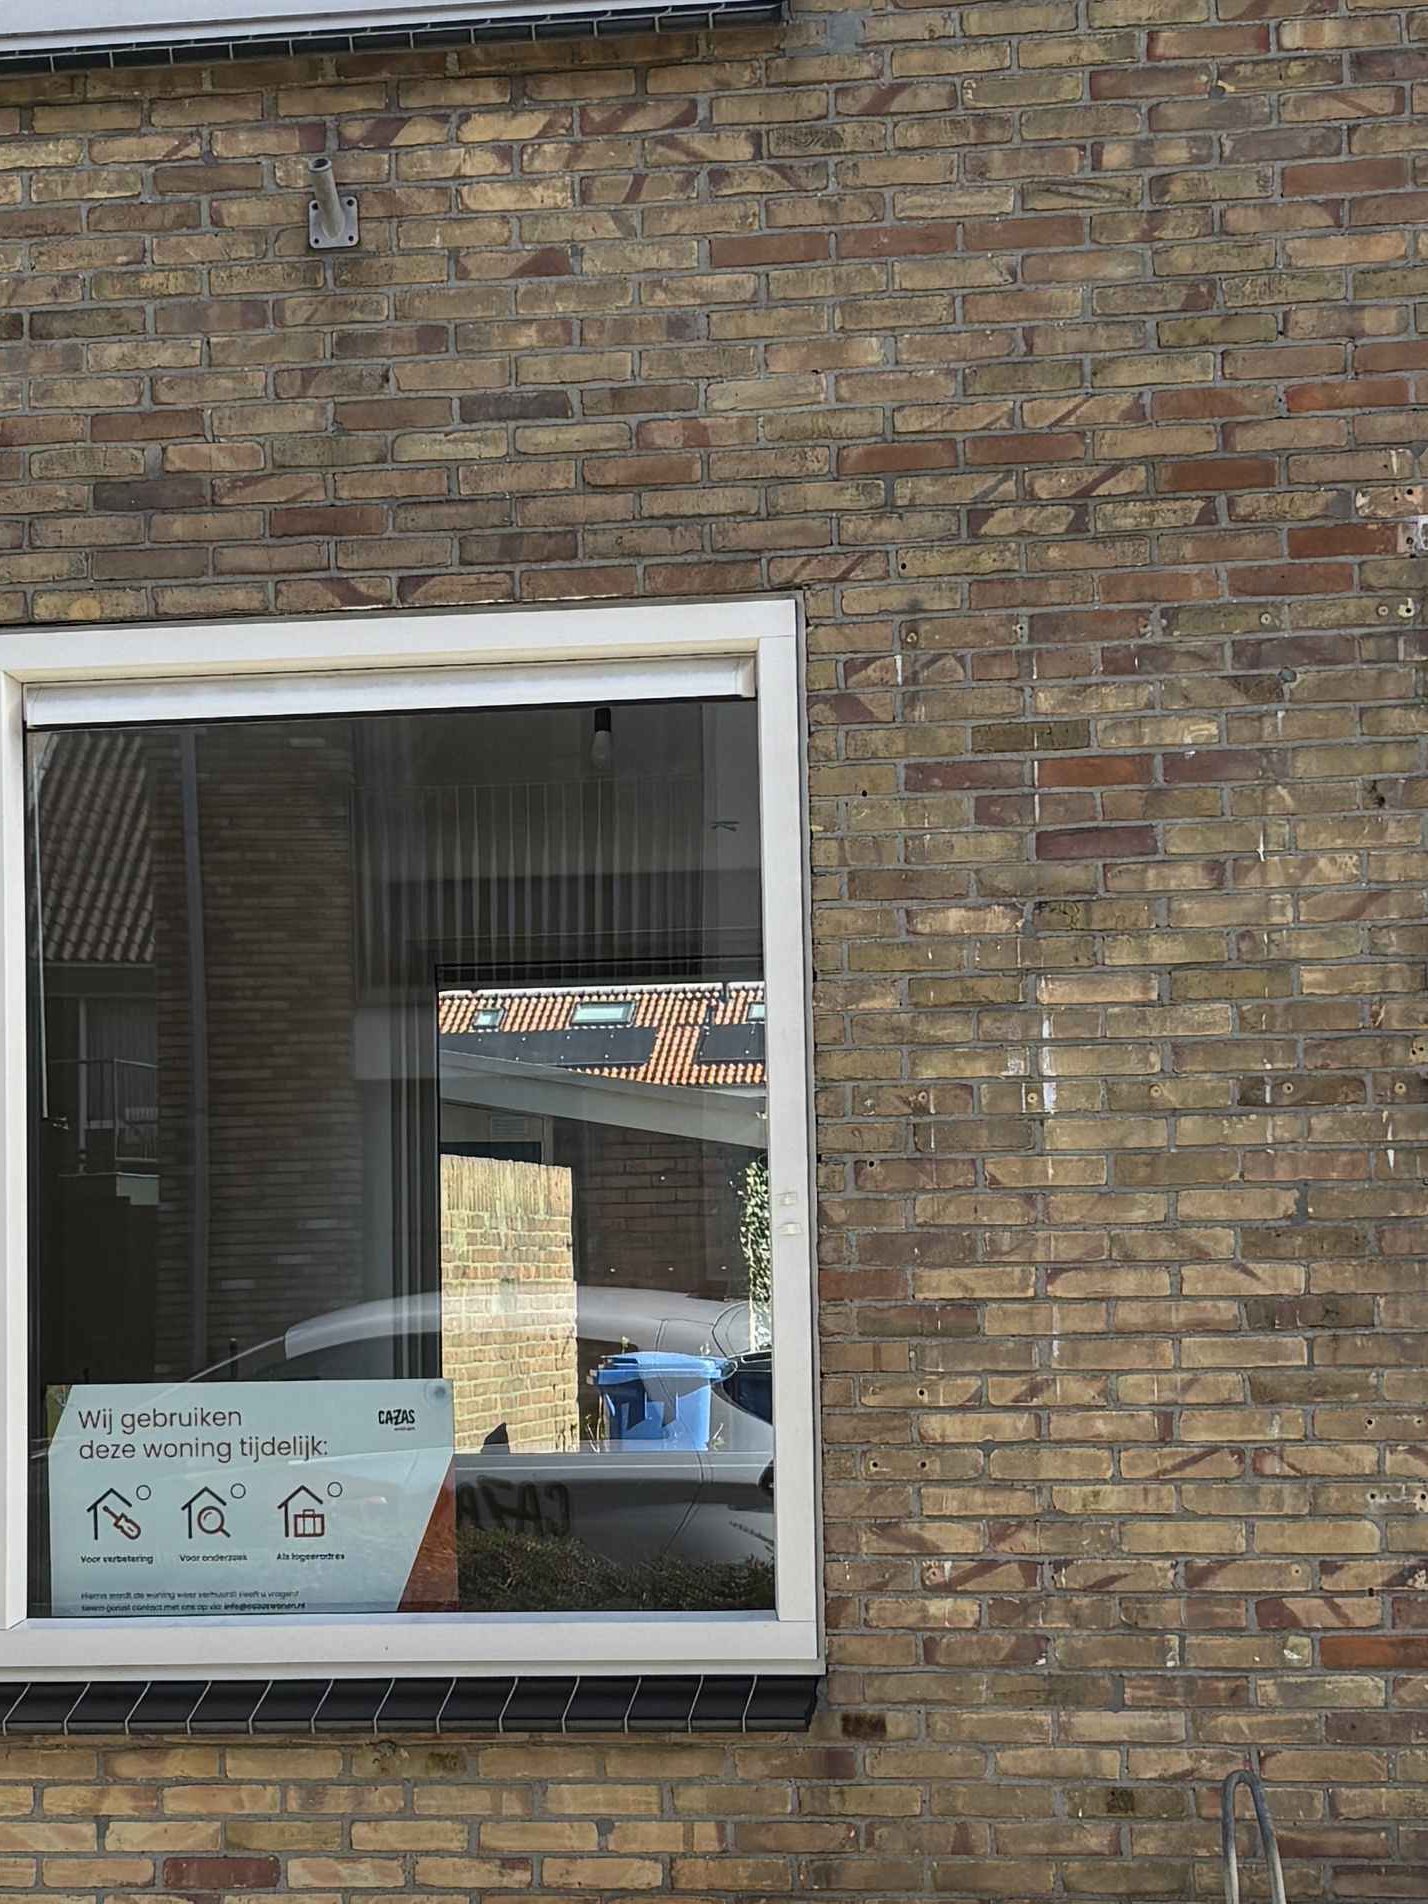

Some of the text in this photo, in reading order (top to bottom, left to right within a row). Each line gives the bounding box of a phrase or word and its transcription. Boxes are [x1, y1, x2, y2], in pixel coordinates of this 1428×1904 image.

[78, 1407, 242, 1435] Wij gebruiken
[378, 1408, 416, 1426] CAZAS
[79, 1435, 329, 1463] deze woning tijdelijk:
[80, 1554, 154, 1565] Voor verbetering
[179, 1554, 200, 1563] Voor
[276, 1552, 290, 1561] Als
